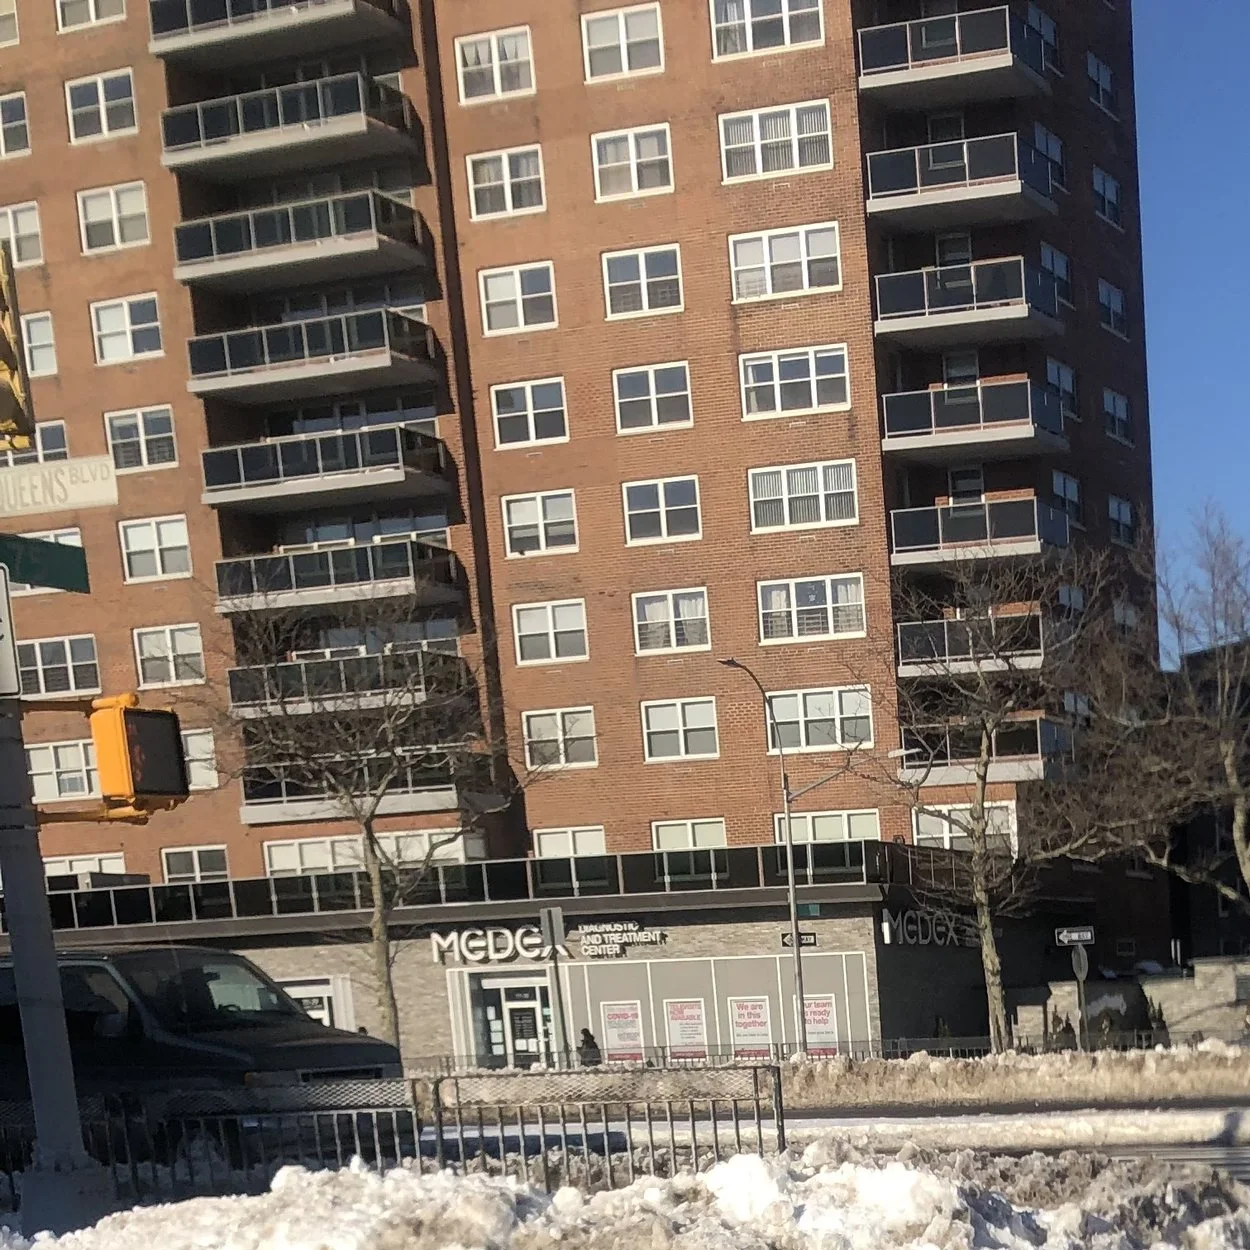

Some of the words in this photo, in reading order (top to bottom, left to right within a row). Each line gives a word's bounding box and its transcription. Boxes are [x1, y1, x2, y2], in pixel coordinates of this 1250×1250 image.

[68, 463, 110, 485] BLVD
[882, 907, 959, 946] MEDEX
[581, 933, 602, 946] AND
[602, 931, 661, 944] TREATMENT
[581, 944, 620, 956] CENTER
[810, 1009, 830, 1018] ready
[735, 1020, 767, 1029] together
[813, 1017, 829, 1026] help
